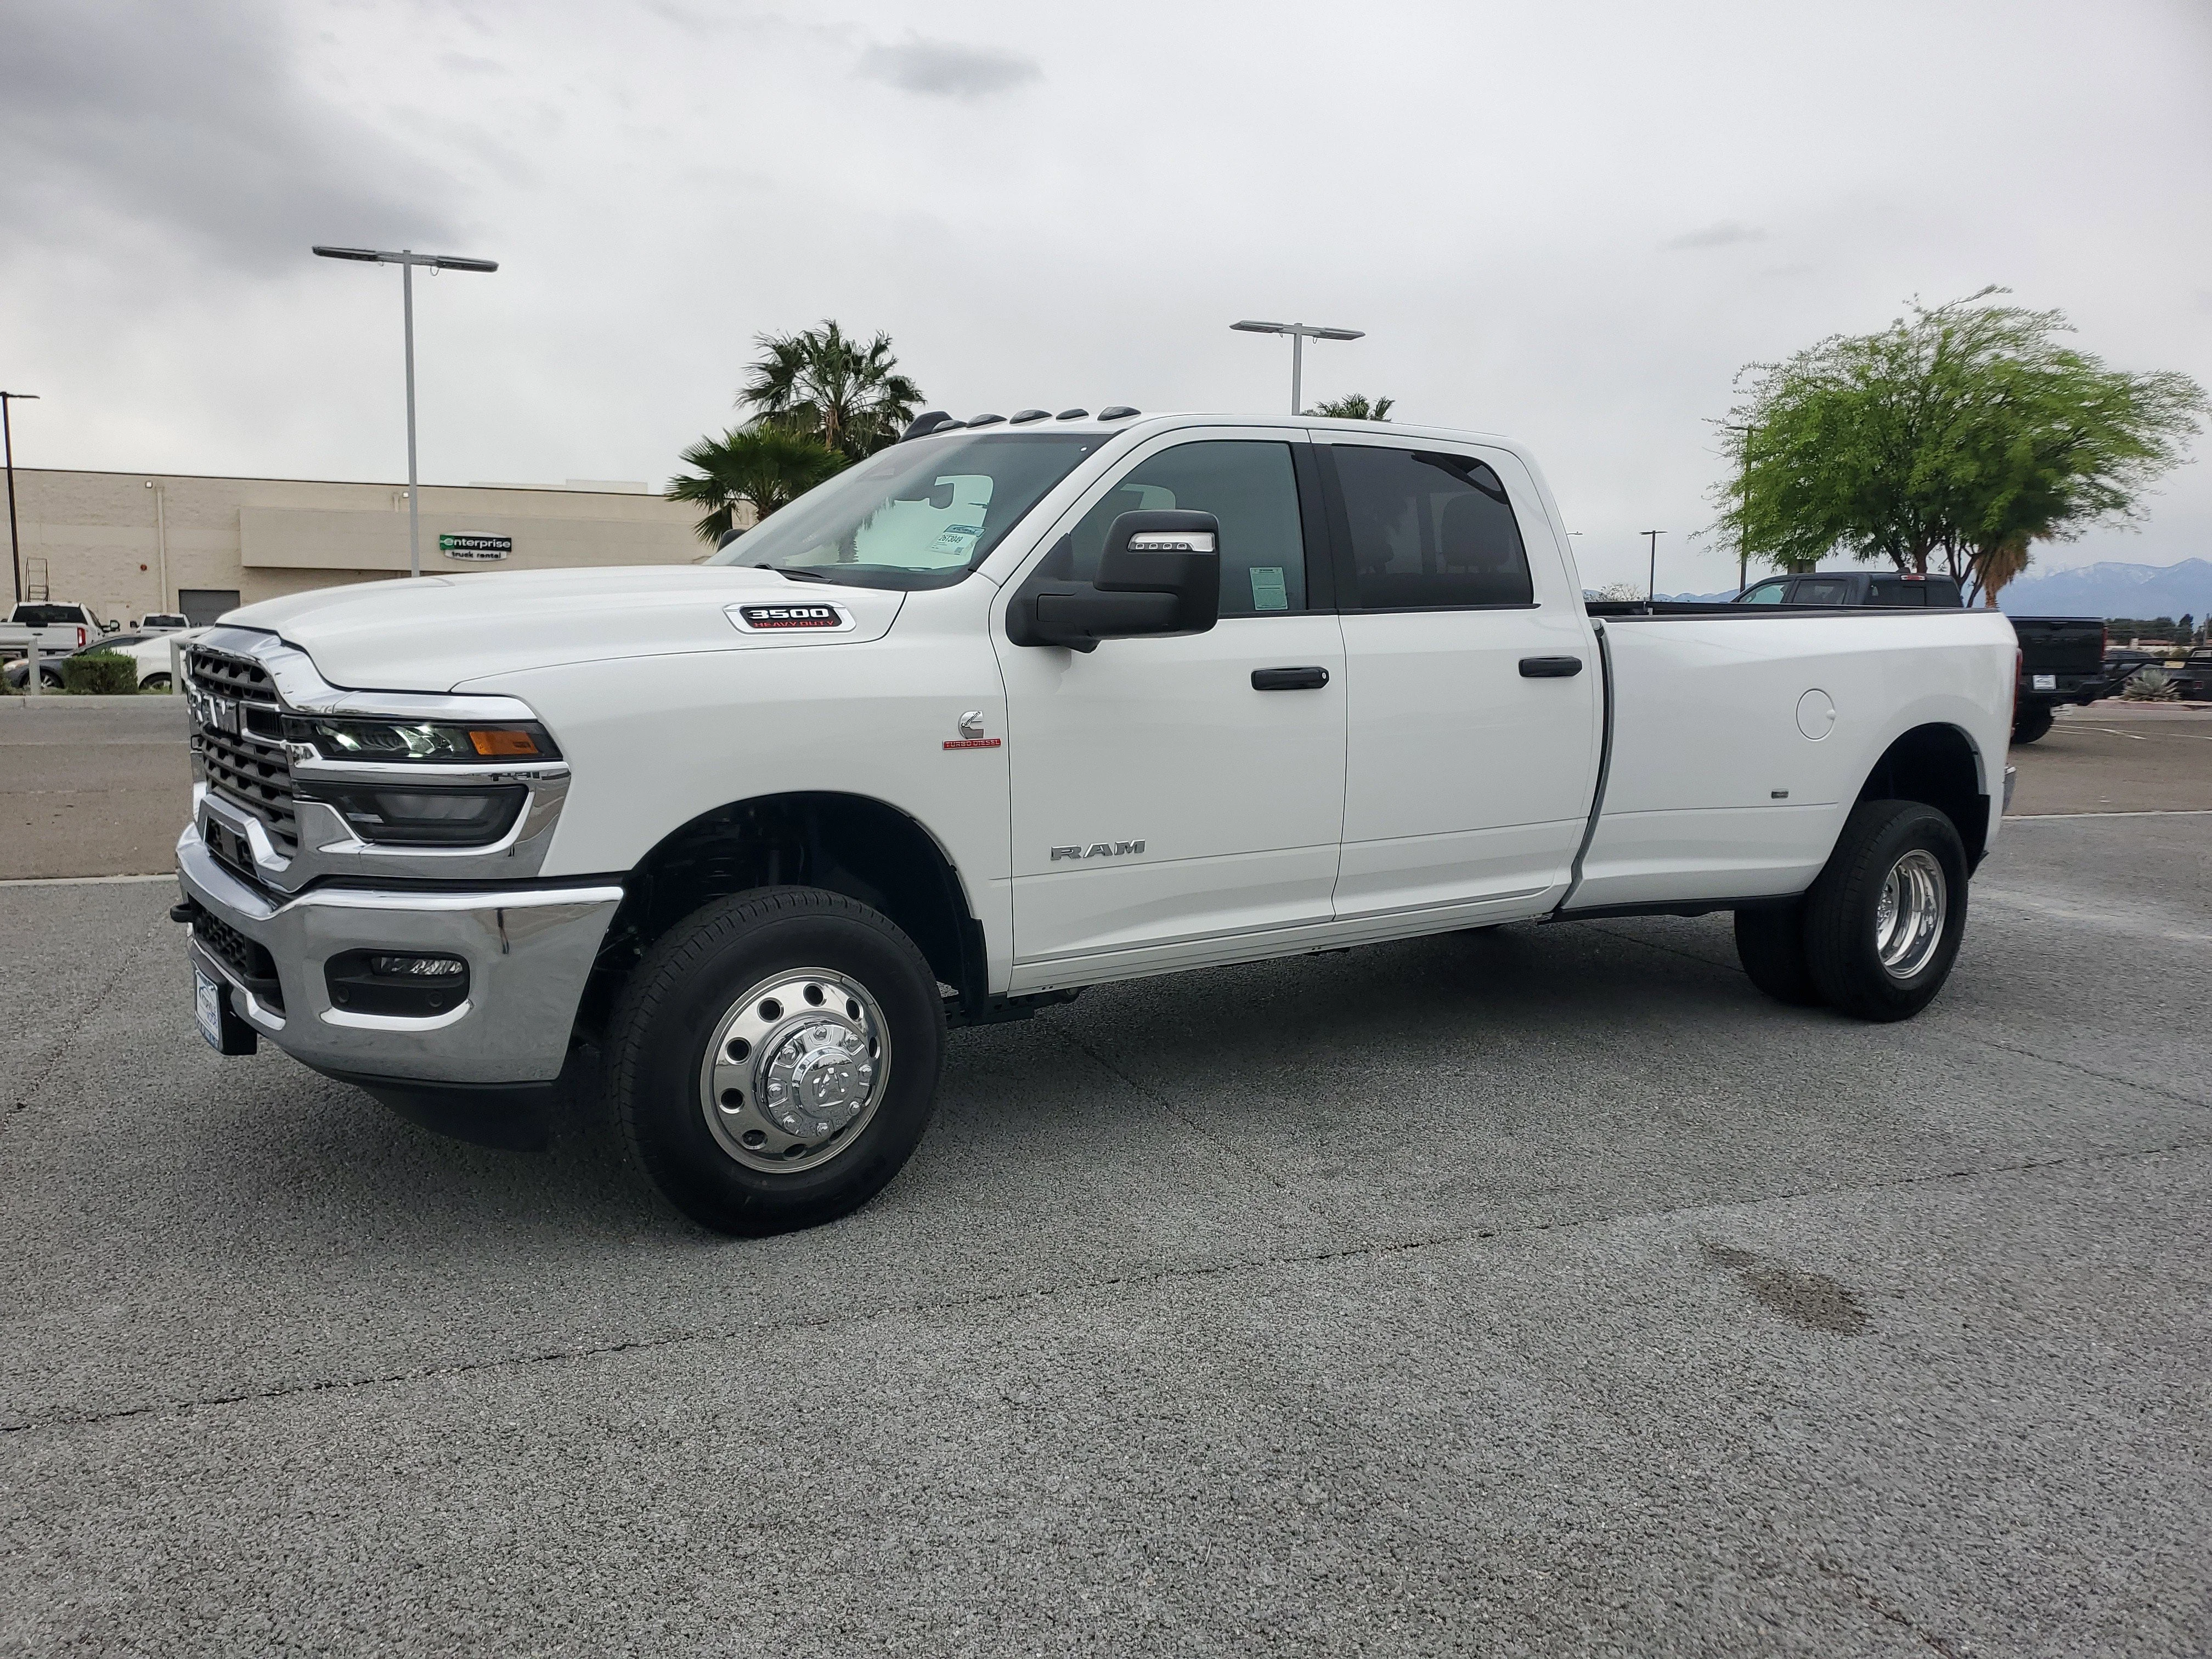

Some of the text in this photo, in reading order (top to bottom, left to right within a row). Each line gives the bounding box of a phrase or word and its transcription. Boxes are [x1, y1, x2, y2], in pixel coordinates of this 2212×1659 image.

[440, 538, 511, 549] enterprise
[747, 608, 830, 619] 3500
[961, 710, 981, 728] Cummins
[1051, 839, 1146, 860] RAM
